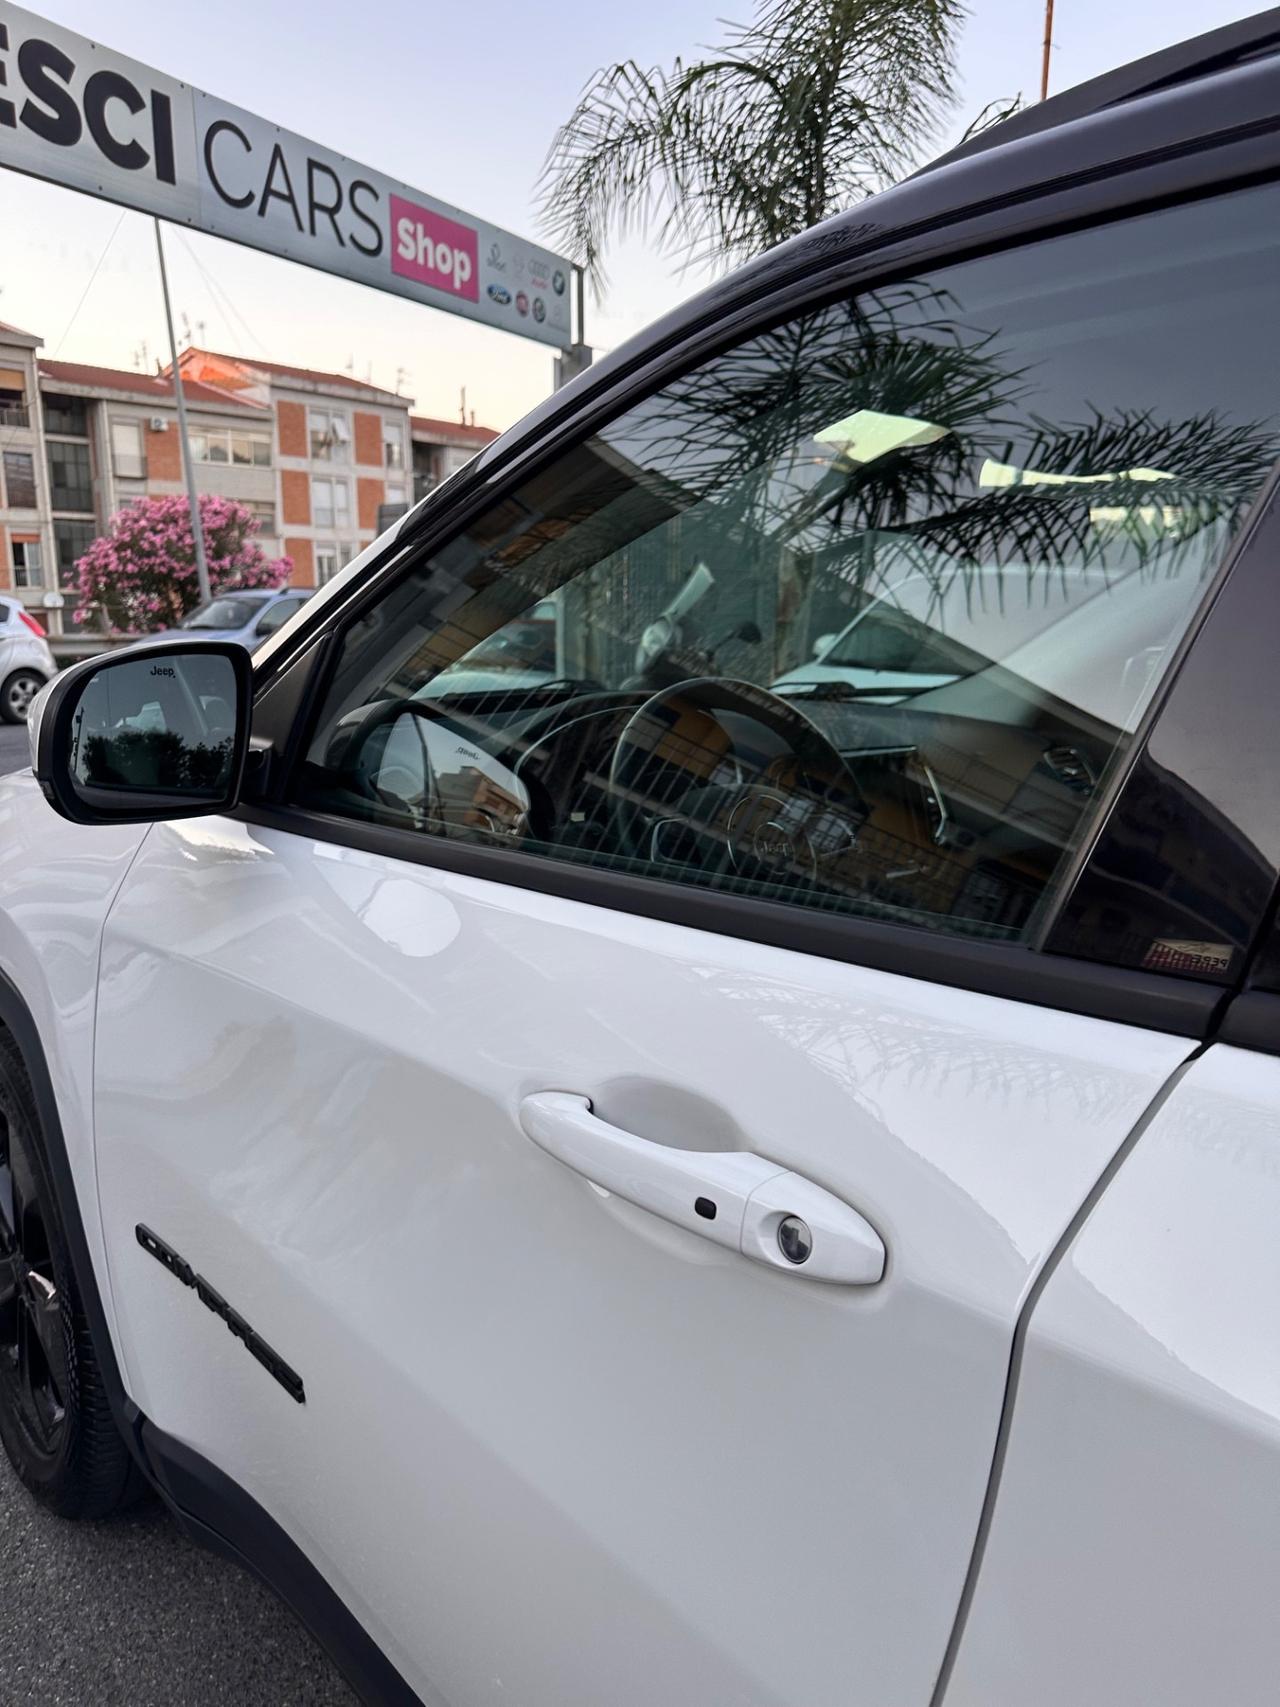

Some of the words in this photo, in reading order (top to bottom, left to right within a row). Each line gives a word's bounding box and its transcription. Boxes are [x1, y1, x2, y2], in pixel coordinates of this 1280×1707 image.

[203, 120, 383, 257] CARS
[396, 217, 472, 289] Shop
[150, 666, 176, 678] Jeep
